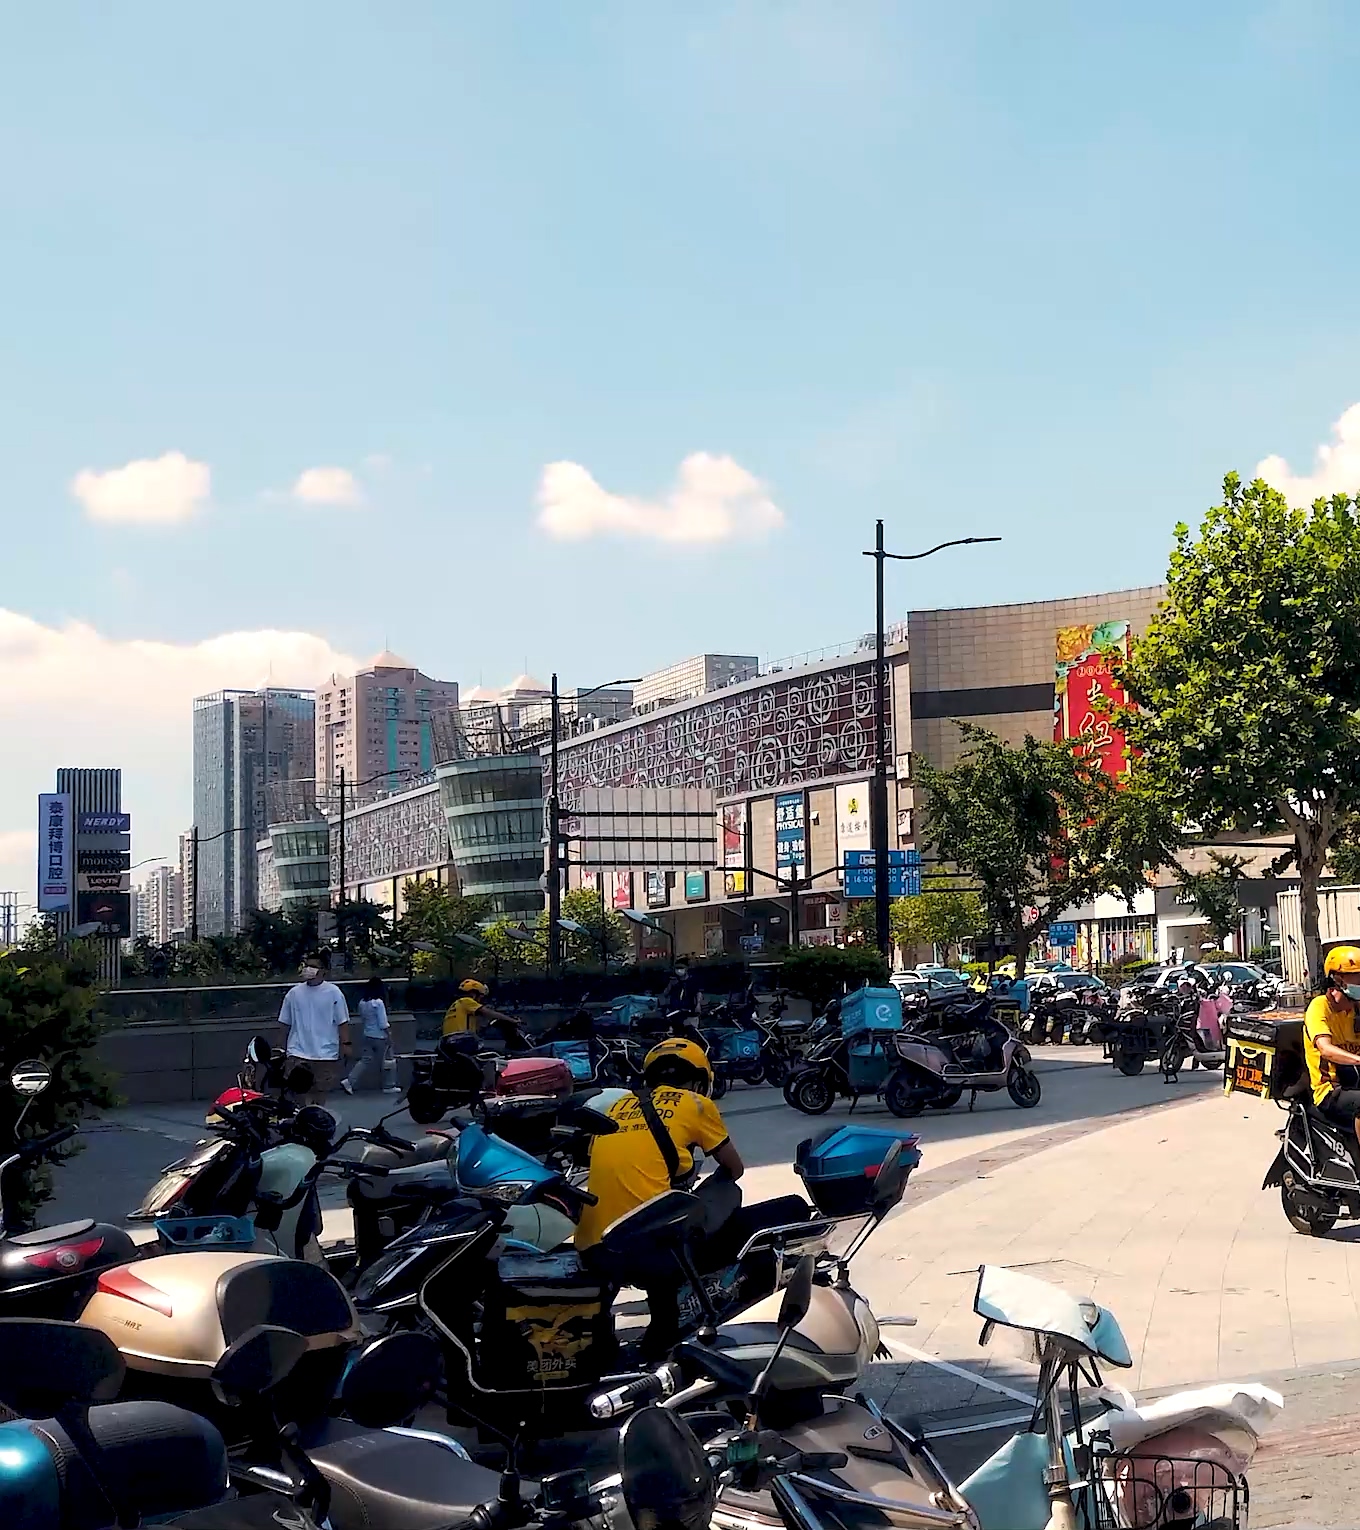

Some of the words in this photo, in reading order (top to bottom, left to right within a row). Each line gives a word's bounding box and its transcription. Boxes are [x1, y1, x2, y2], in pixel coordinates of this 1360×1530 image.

[83, 816, 125, 827] NERDY
[776, 818, 804, 831] PHYSICAL
[48, 800, 64, 880] 泰康拜博口腔
[81, 855, 127, 867] moussy
[526, 1357, 577, 1373] 美团外卖
